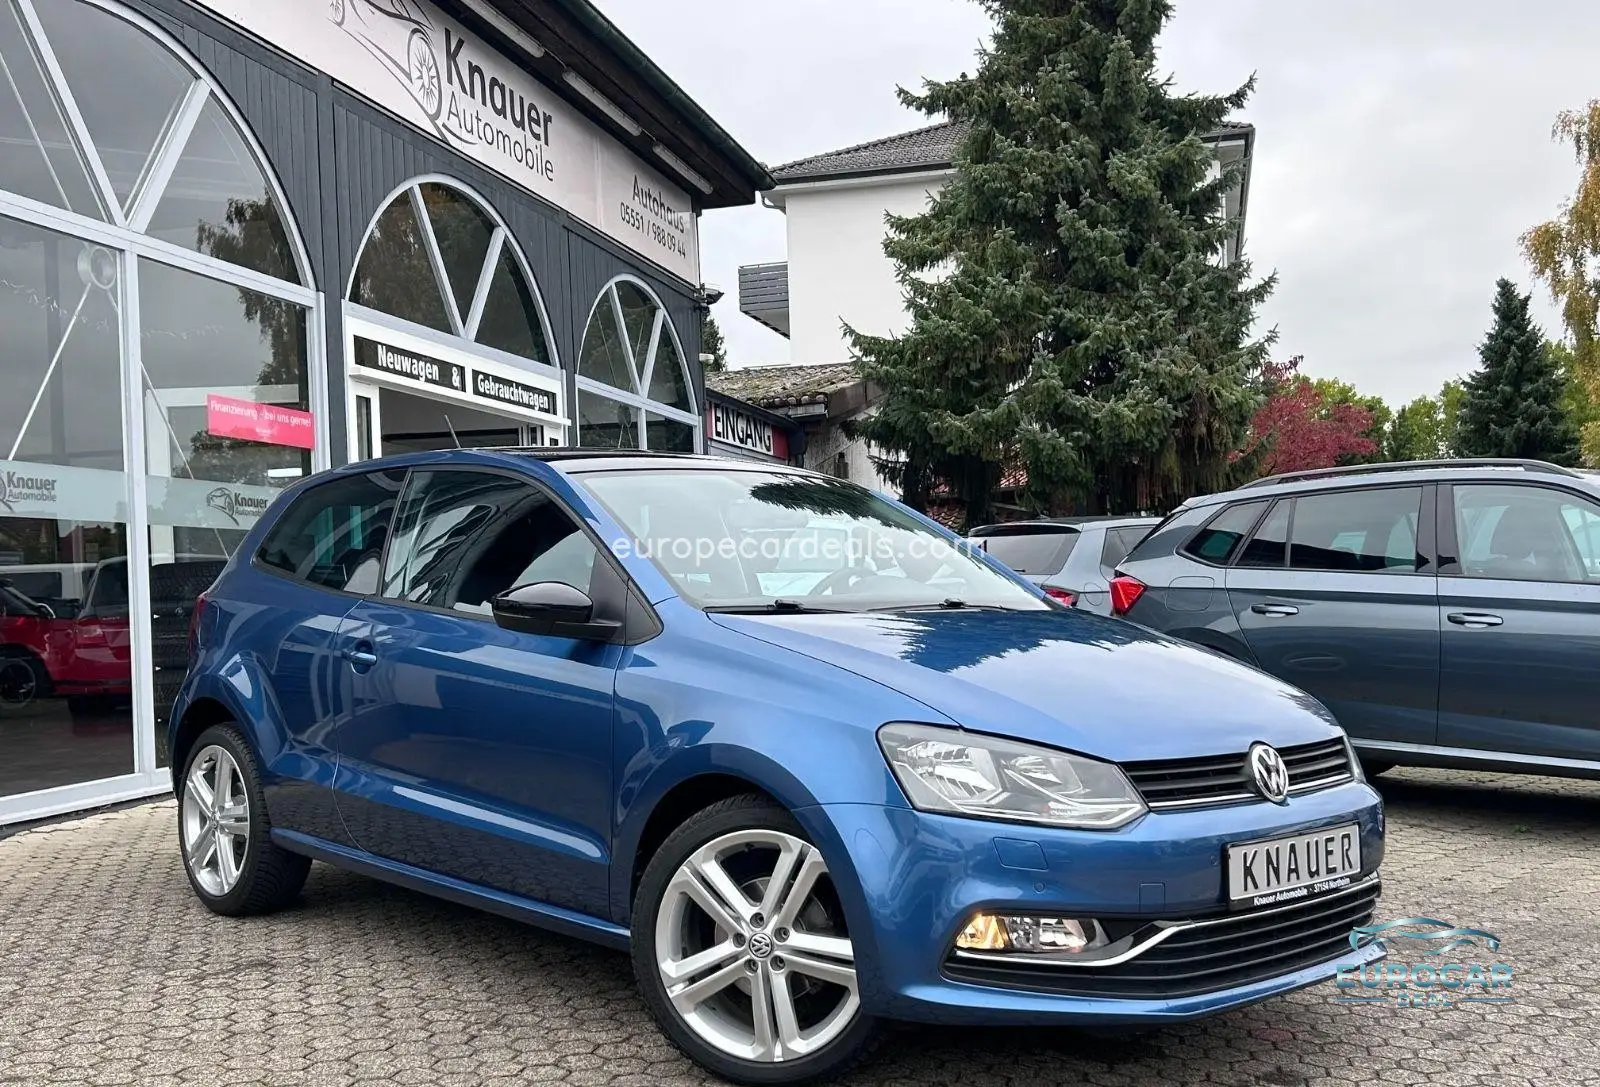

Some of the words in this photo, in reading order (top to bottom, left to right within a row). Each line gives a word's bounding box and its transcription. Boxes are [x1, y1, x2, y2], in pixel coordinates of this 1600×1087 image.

[444, 28, 553, 146] Knauer
[446, 91, 554, 182] Automobile
[620, 202, 644, 233] 05551
[651, 222, 666, 247] 988
[666, 232, 676, 253] 09
[677, 239, 686, 259] 44
[632, 174, 685, 234] Autohaus
[377, 344, 440, 382] Neuwagen
[451, 366, 461, 388] &
[477, 374, 549, 411] Gebrauchtwagen
[210, 400, 258, 420] Finanzierung
[264, 407, 276, 420] bei
[276, 413, 290, 423] uns
[714, 403, 773, 453] EINGANG
[6, 471, 57, 491] Knauer
[8, 489, 57, 501] Automobile
[234, 492, 268, 509] Knauer
[1242, 832, 1353, 893] KNAUER
[1253, 894, 1276, 906] Knauer
[1276, 886, 1308, 902] Automobile
[1329, 876, 1351, 890] Northeim
